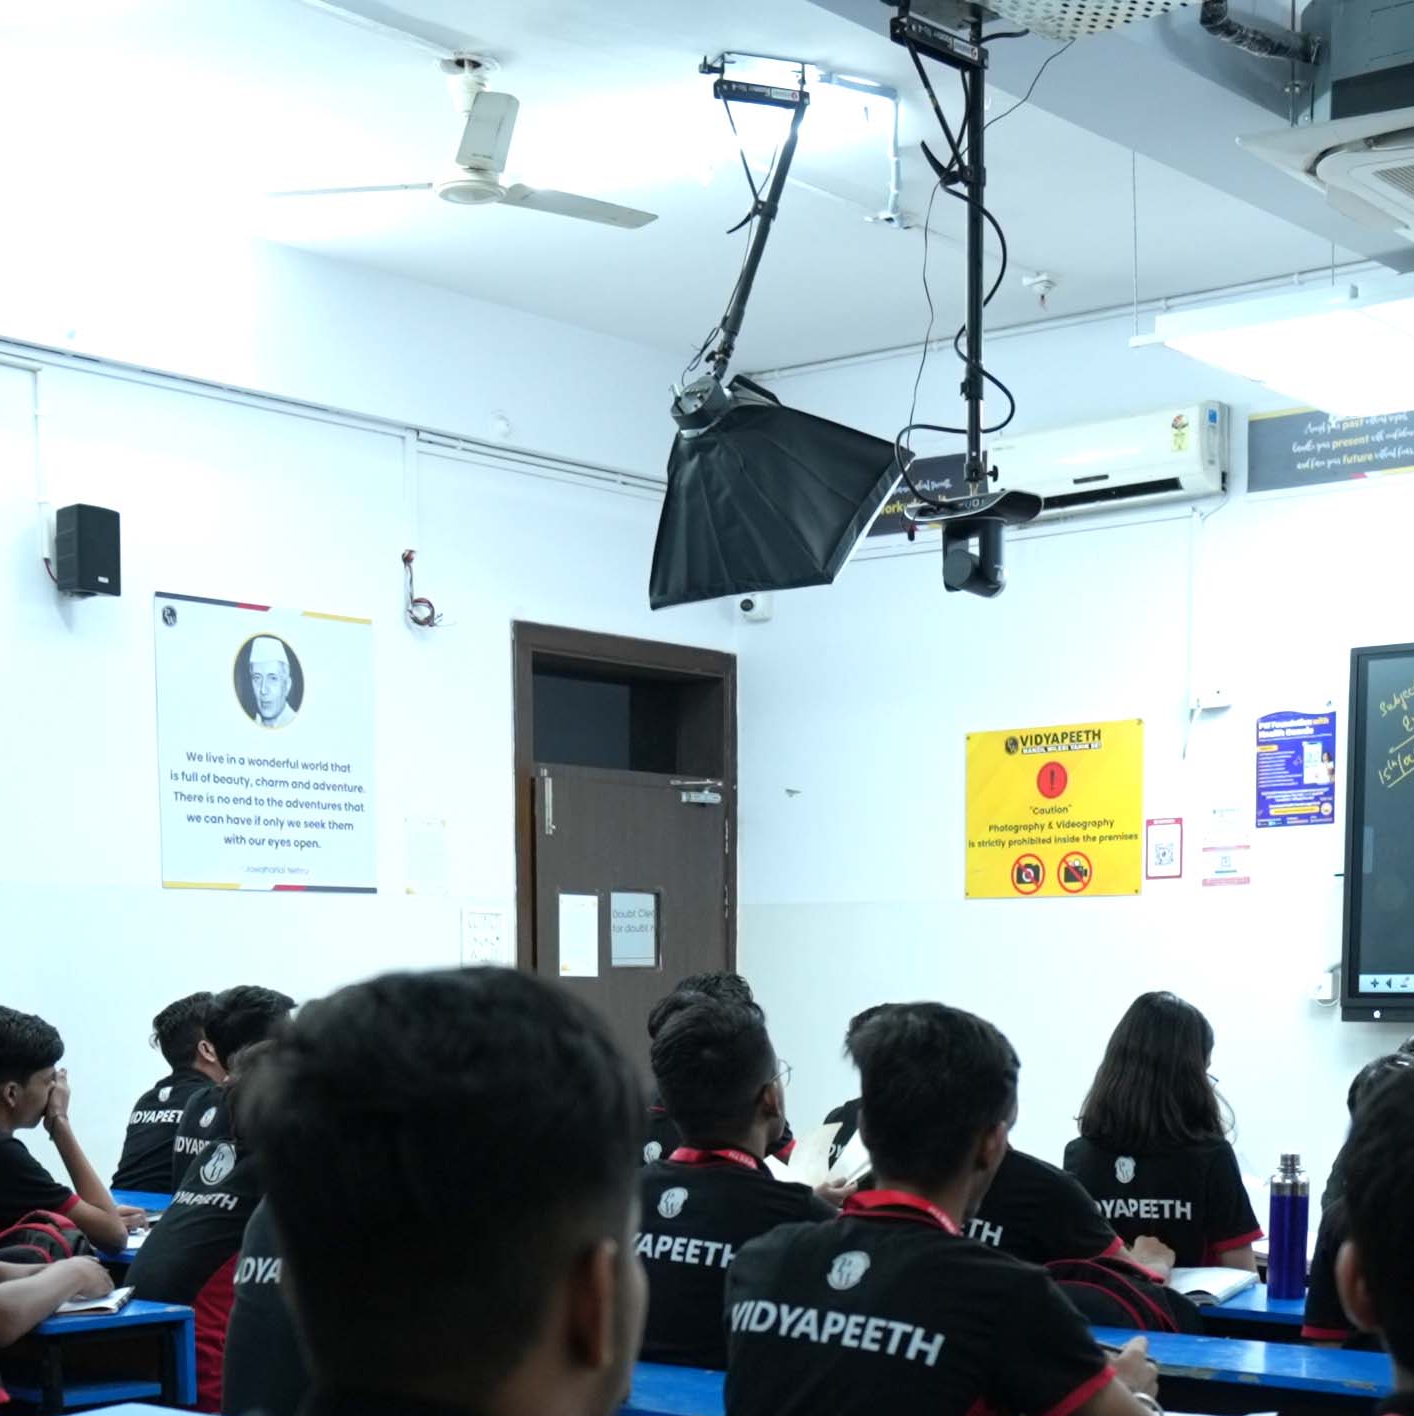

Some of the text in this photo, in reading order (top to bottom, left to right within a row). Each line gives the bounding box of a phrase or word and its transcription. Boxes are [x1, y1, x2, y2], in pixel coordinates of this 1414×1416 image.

[1332, 435, 1369, 449] present
[1343, 453, 1373, 464] future
[1020, 729, 1101, 746] VIDYAPEETH
[186, 752, 350, 773] We live in a wonderful world that
[170, 770, 179, 781] is
[181, 771, 198, 782] full
[201, 772, 211, 782] of
[213, 773, 253, 789] beauty,
[255, 777, 289, 788] charm
[291, 779, 310, 790] and
[174, 791, 364, 812] There is no end to the adventures that
[187, 814, 354, 830] we can have if only we seek them
[989, 821, 1045, 833] Photography
[1056, 819, 1114, 829] Videography
[224, 834, 321, 851] with our eyes open.
[978, 838, 1006, 848] strictly
[1008, 836, 1052, 847] prohibited
[1083, 835, 1096, 843] the
[1099, 833, 1138, 843] premises
[730, 1300, 945, 1368] VIDYAPEETH
